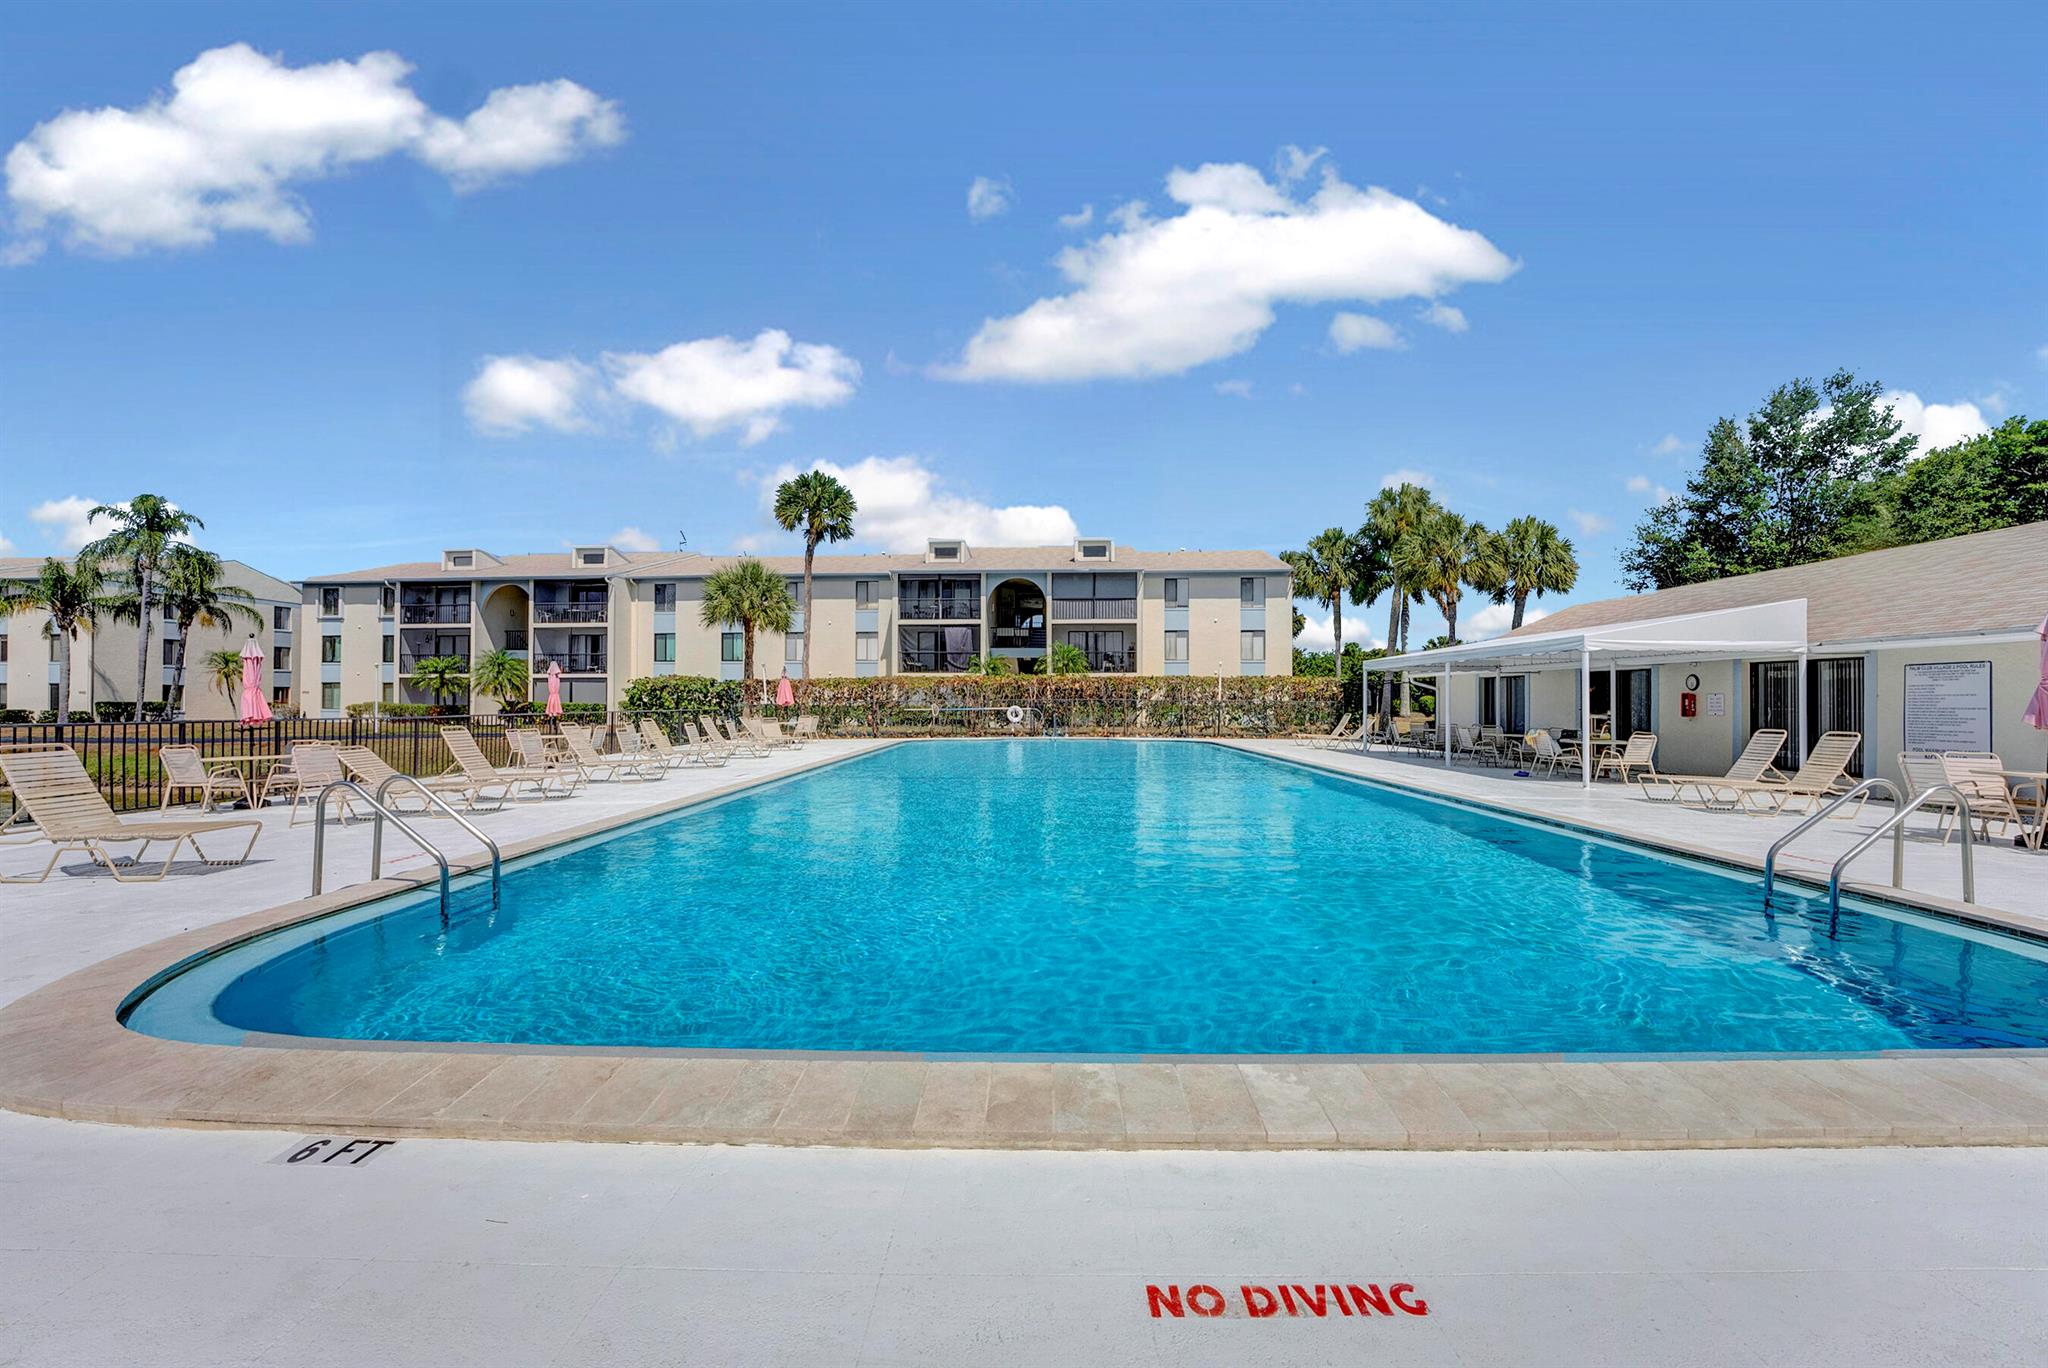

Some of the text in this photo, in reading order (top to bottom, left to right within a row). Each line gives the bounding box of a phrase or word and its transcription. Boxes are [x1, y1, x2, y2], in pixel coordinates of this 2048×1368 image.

[287, 1140, 396, 1164] 6 FT
[1145, 1283, 1430, 1318] NO DIVING
